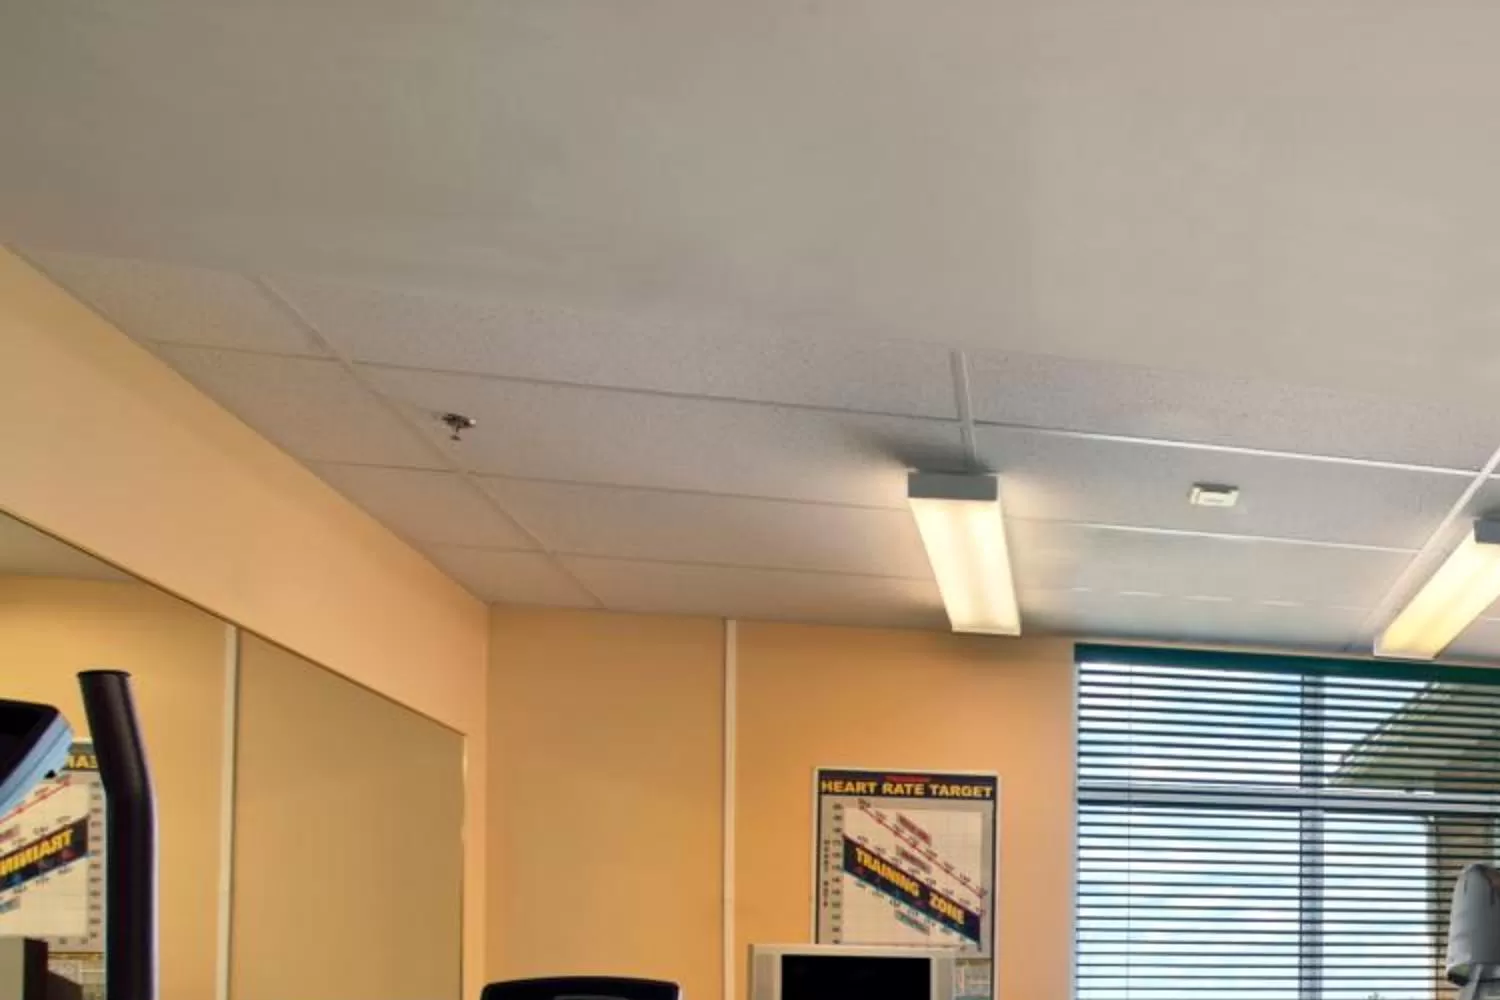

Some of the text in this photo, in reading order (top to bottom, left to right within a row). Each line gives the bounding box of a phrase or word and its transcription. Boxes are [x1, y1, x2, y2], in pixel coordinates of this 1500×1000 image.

[821, 779, 877, 794] HEART
[881, 781, 924, 796] RATE
[929, 783, 993, 799] TARGET
[856, 847, 920, 897] TRAINING
[929, 892, 965, 925] ZONE
